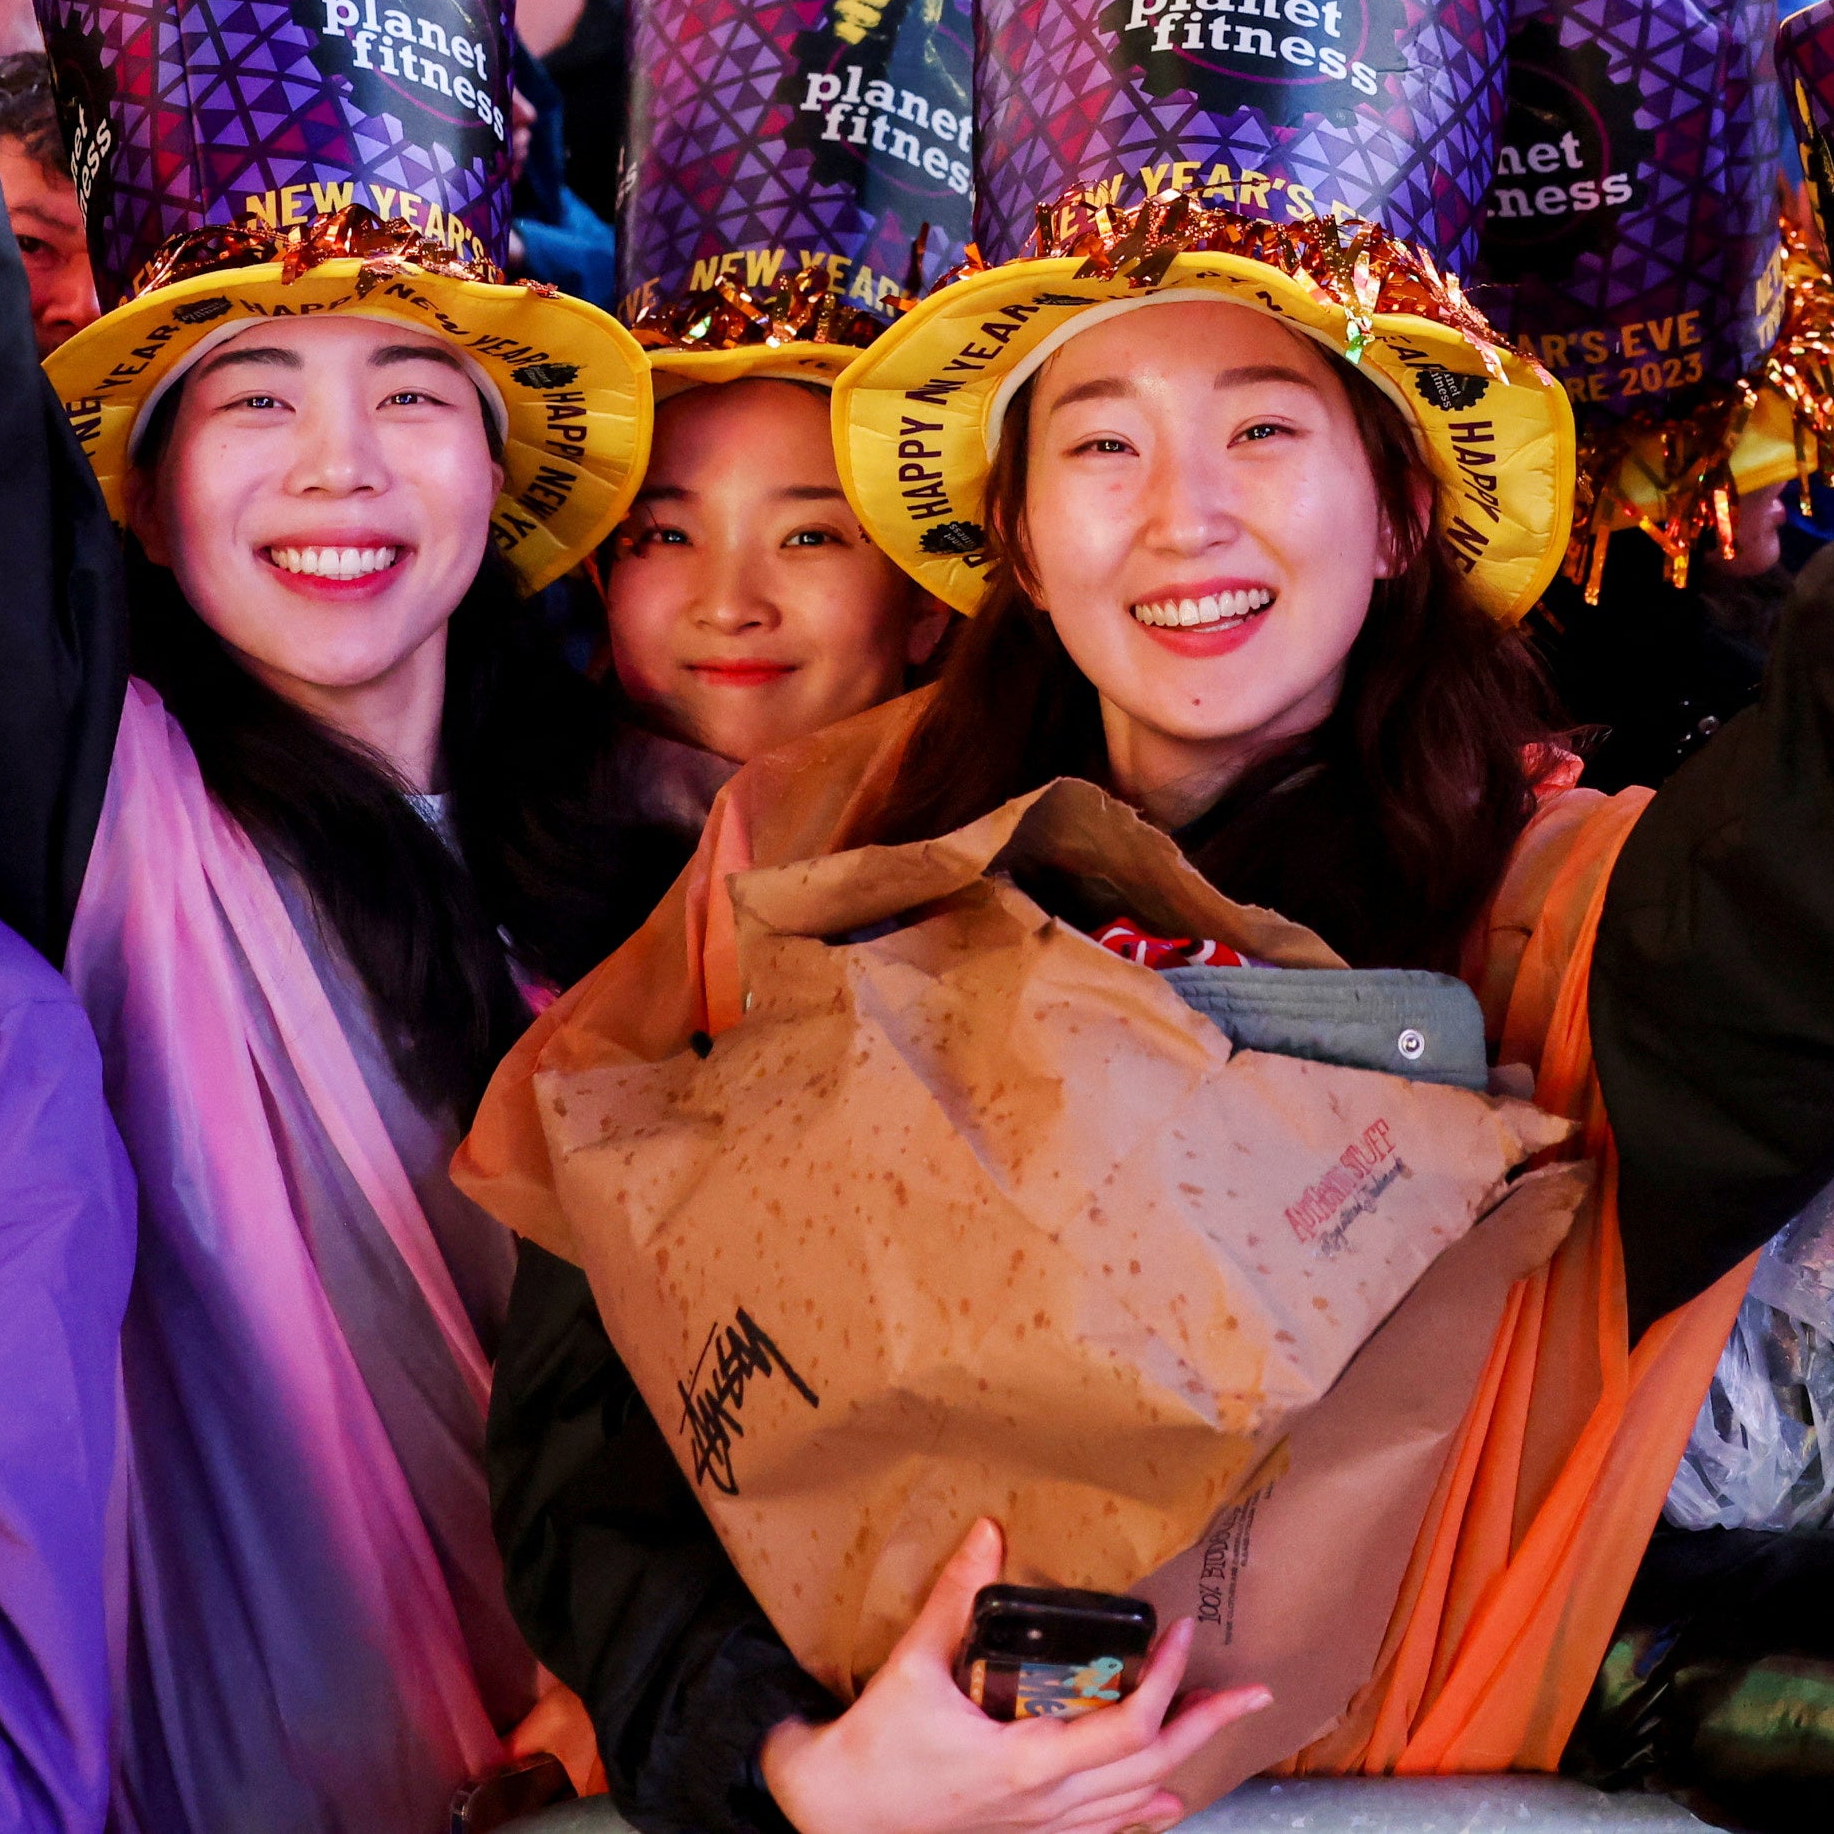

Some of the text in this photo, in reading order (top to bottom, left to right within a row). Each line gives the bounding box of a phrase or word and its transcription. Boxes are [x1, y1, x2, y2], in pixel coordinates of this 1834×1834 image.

[352, 32, 505, 143] fitness
[1150, 11, 1379, 96] fitness
[799, 65, 972, 154] planet
[820, 104, 973, 196] fitnes
[1497, 130, 1584, 176] net
[245, 181, 487, 266] NEW YEAR'S
[1059, 161, 1316, 241] EW YEAR'S
[1487, 172, 1634, 218] ness
[625, 277, 661, 319] VE
[689, 248, 903, 319] NEW YEAR
[93, 323, 181, 391] YEAR
[384, 281, 470, 336] NEW
[465, 333, 550, 368] YEAR
[942, 303, 1041, 372] YEAR
[1516, 330, 1610, 370] AR'S
[1620, 310, 1703, 360] EVE
[1618, 351, 1704, 397] 2023
[65, 392, 113, 448] NE
[898, 415, 954, 521] HAPPY
[1447, 420, 1502, 524] HAPPY
[1197, 1582, 1223, 1626] 100%
